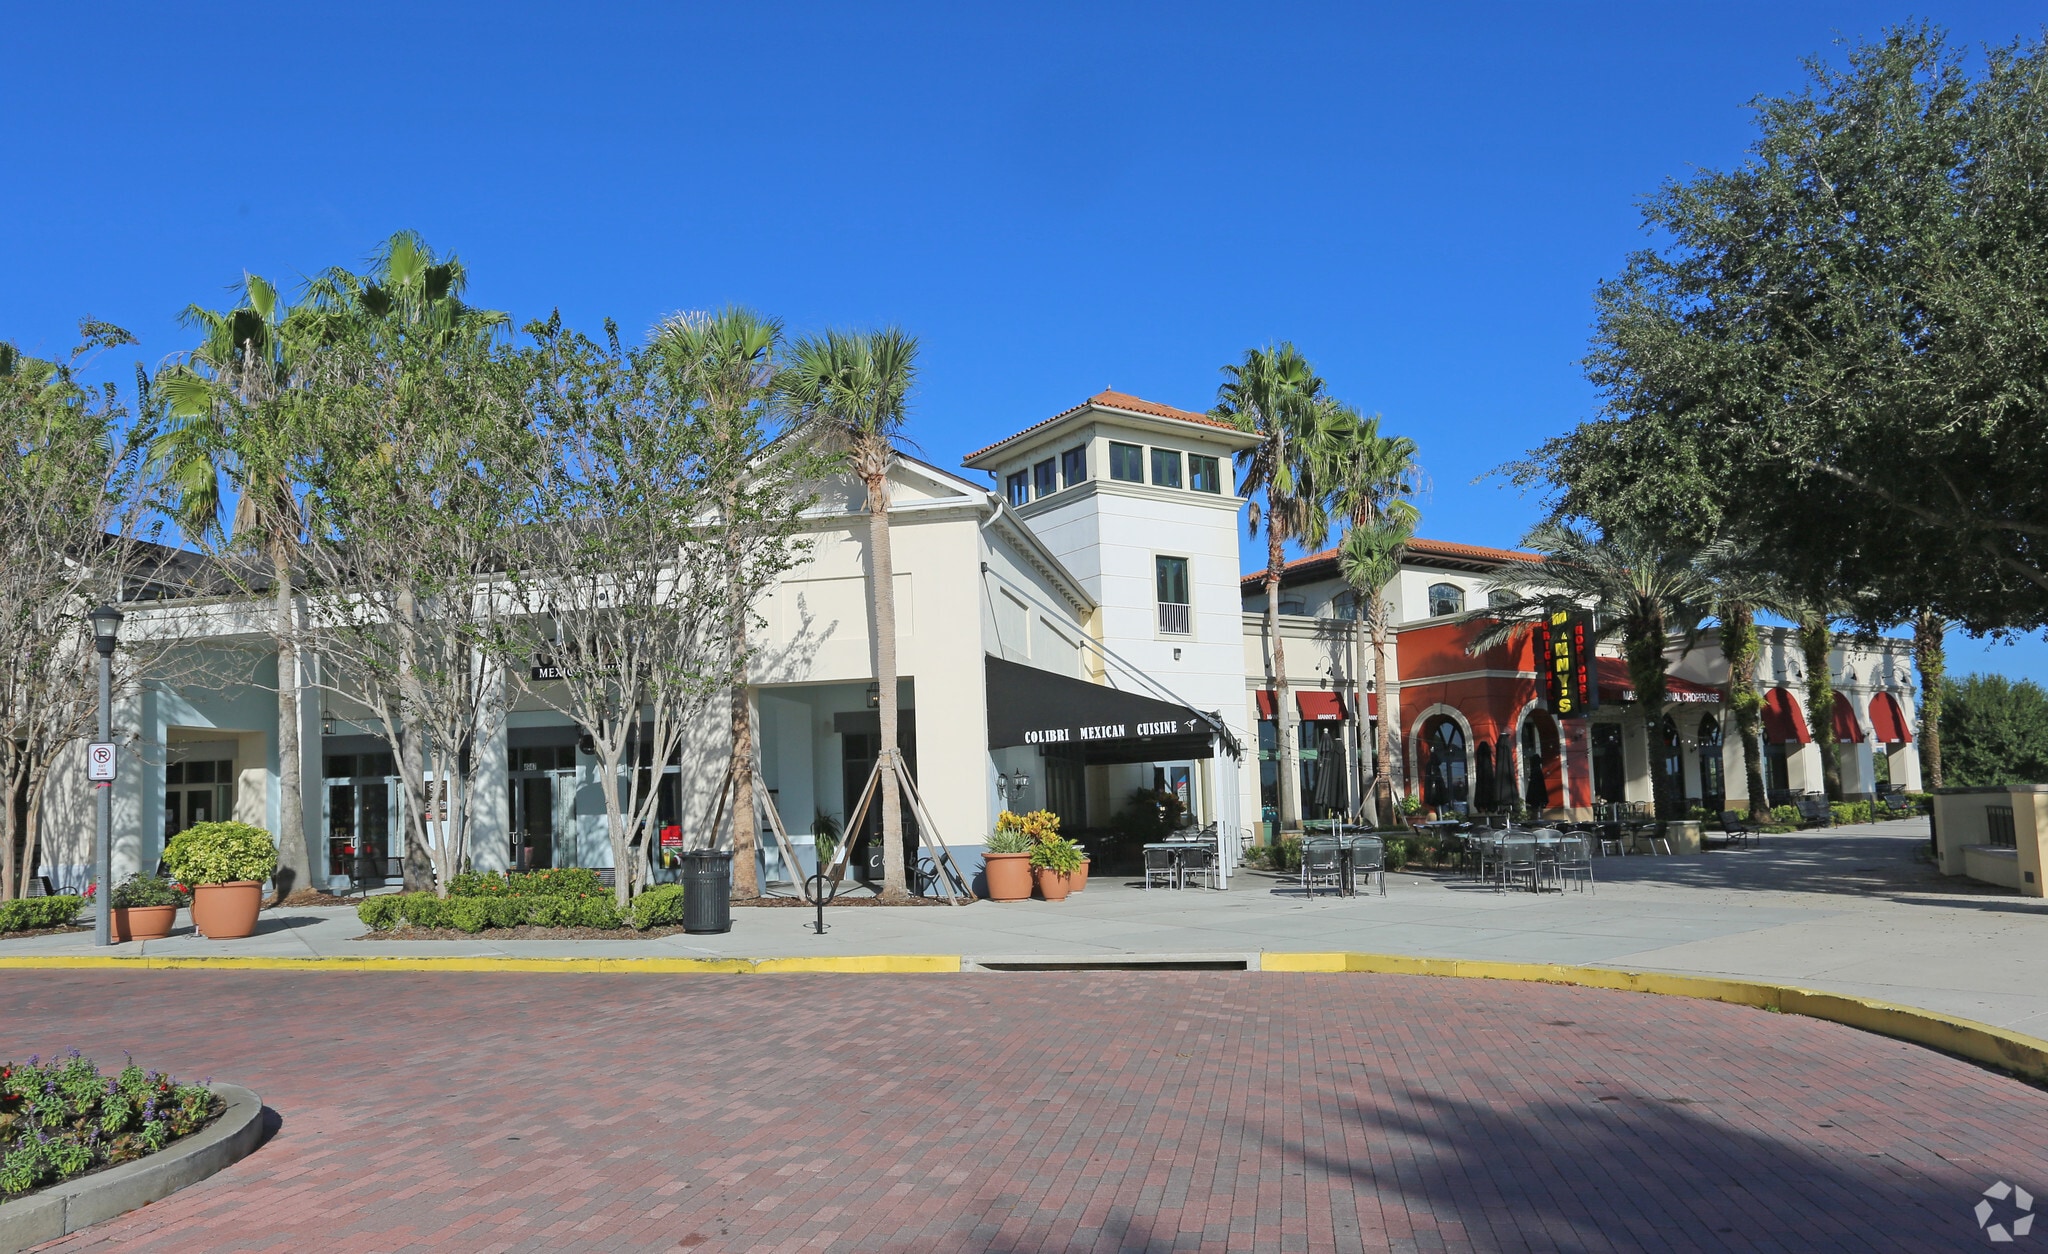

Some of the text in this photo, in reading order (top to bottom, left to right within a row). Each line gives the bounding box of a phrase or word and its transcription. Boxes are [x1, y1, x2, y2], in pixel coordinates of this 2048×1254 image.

[1575, 621, 1588, 704] HOPHOUSE
[1664, 692, 1719, 703] GINAL CHOPHOUSE
[1024, 720, 1178, 744] COLIBRI MEXICAN CUISINE
